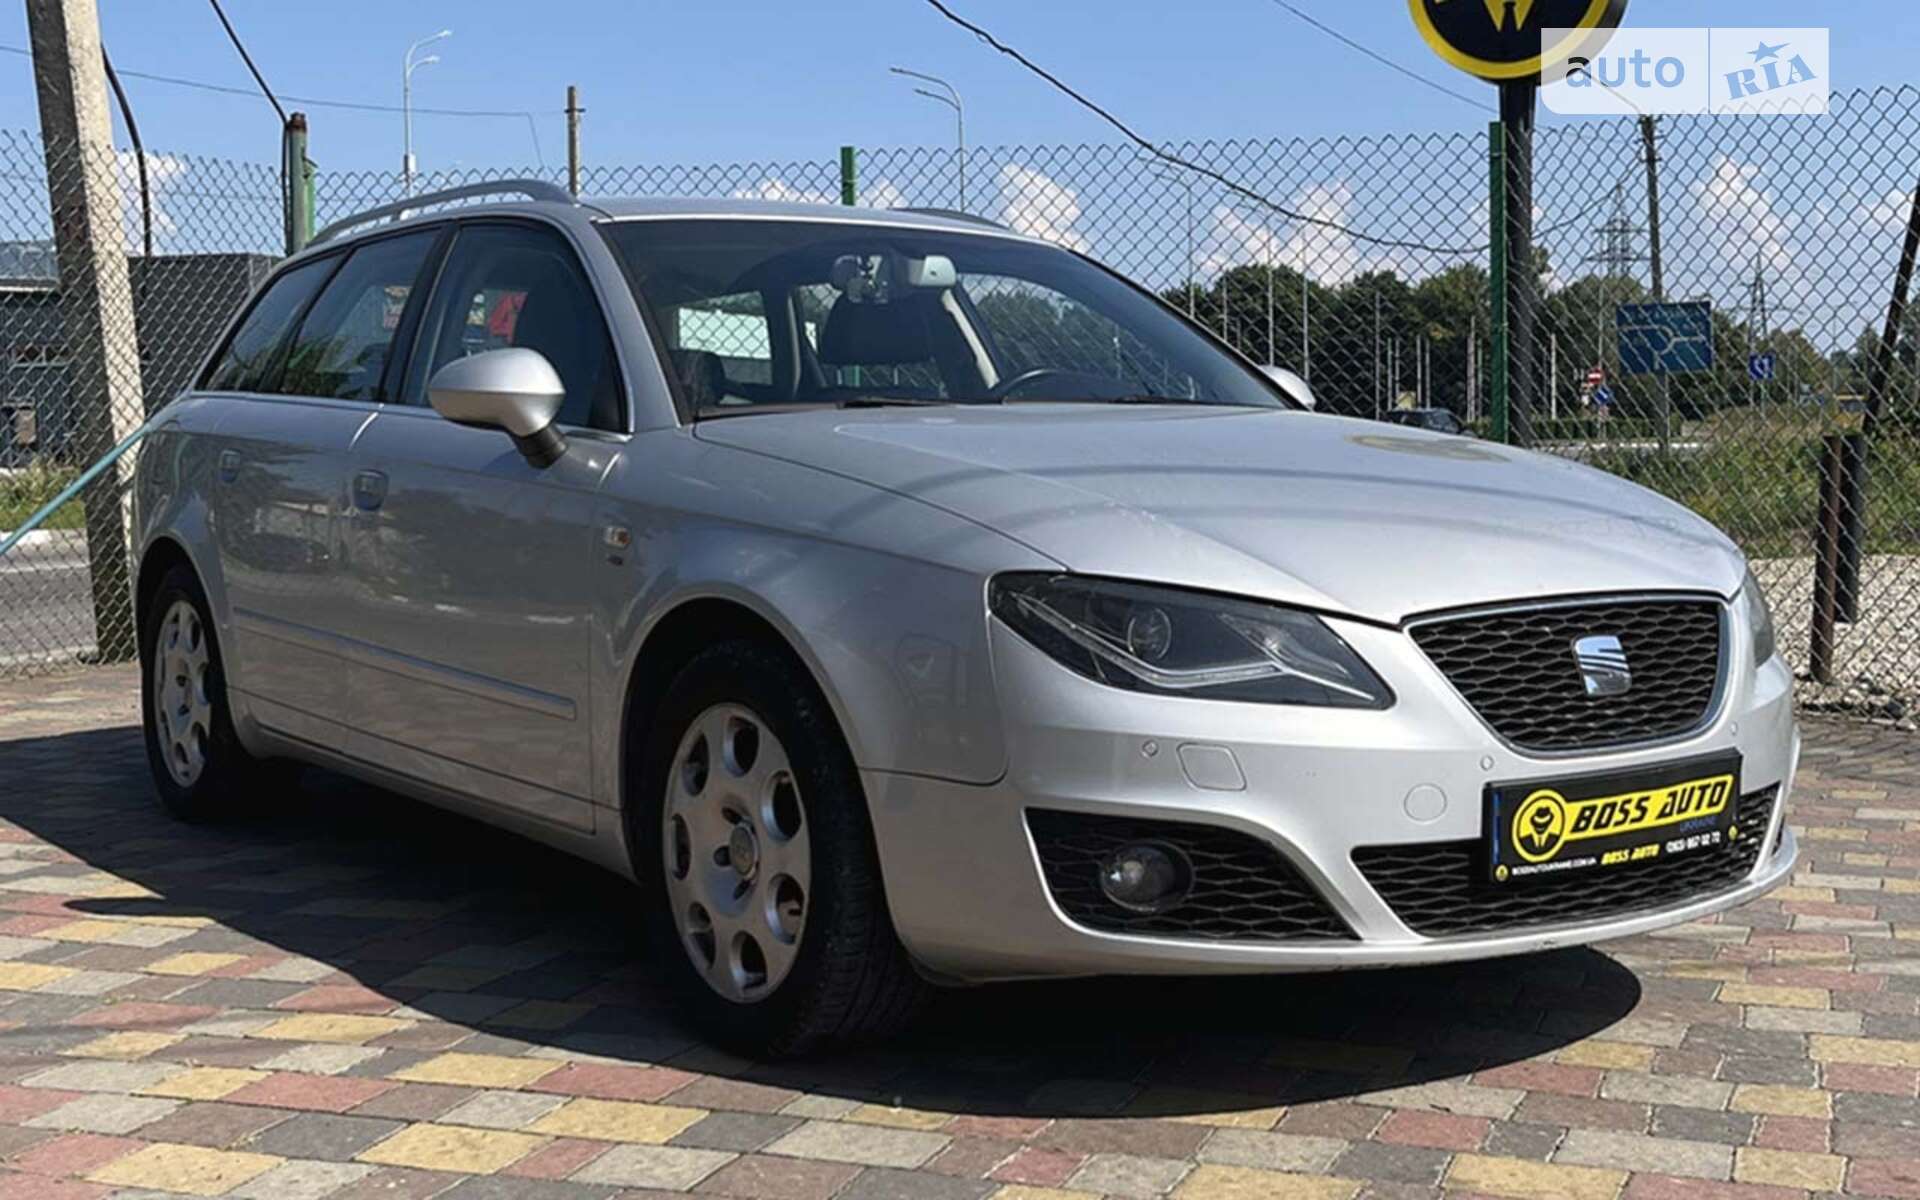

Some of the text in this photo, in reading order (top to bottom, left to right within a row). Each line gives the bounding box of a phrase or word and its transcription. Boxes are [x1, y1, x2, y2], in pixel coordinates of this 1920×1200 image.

[1571, 780, 1728, 833] BOSS AUTO
[1600, 843, 1660, 865] BOSS AUTO
